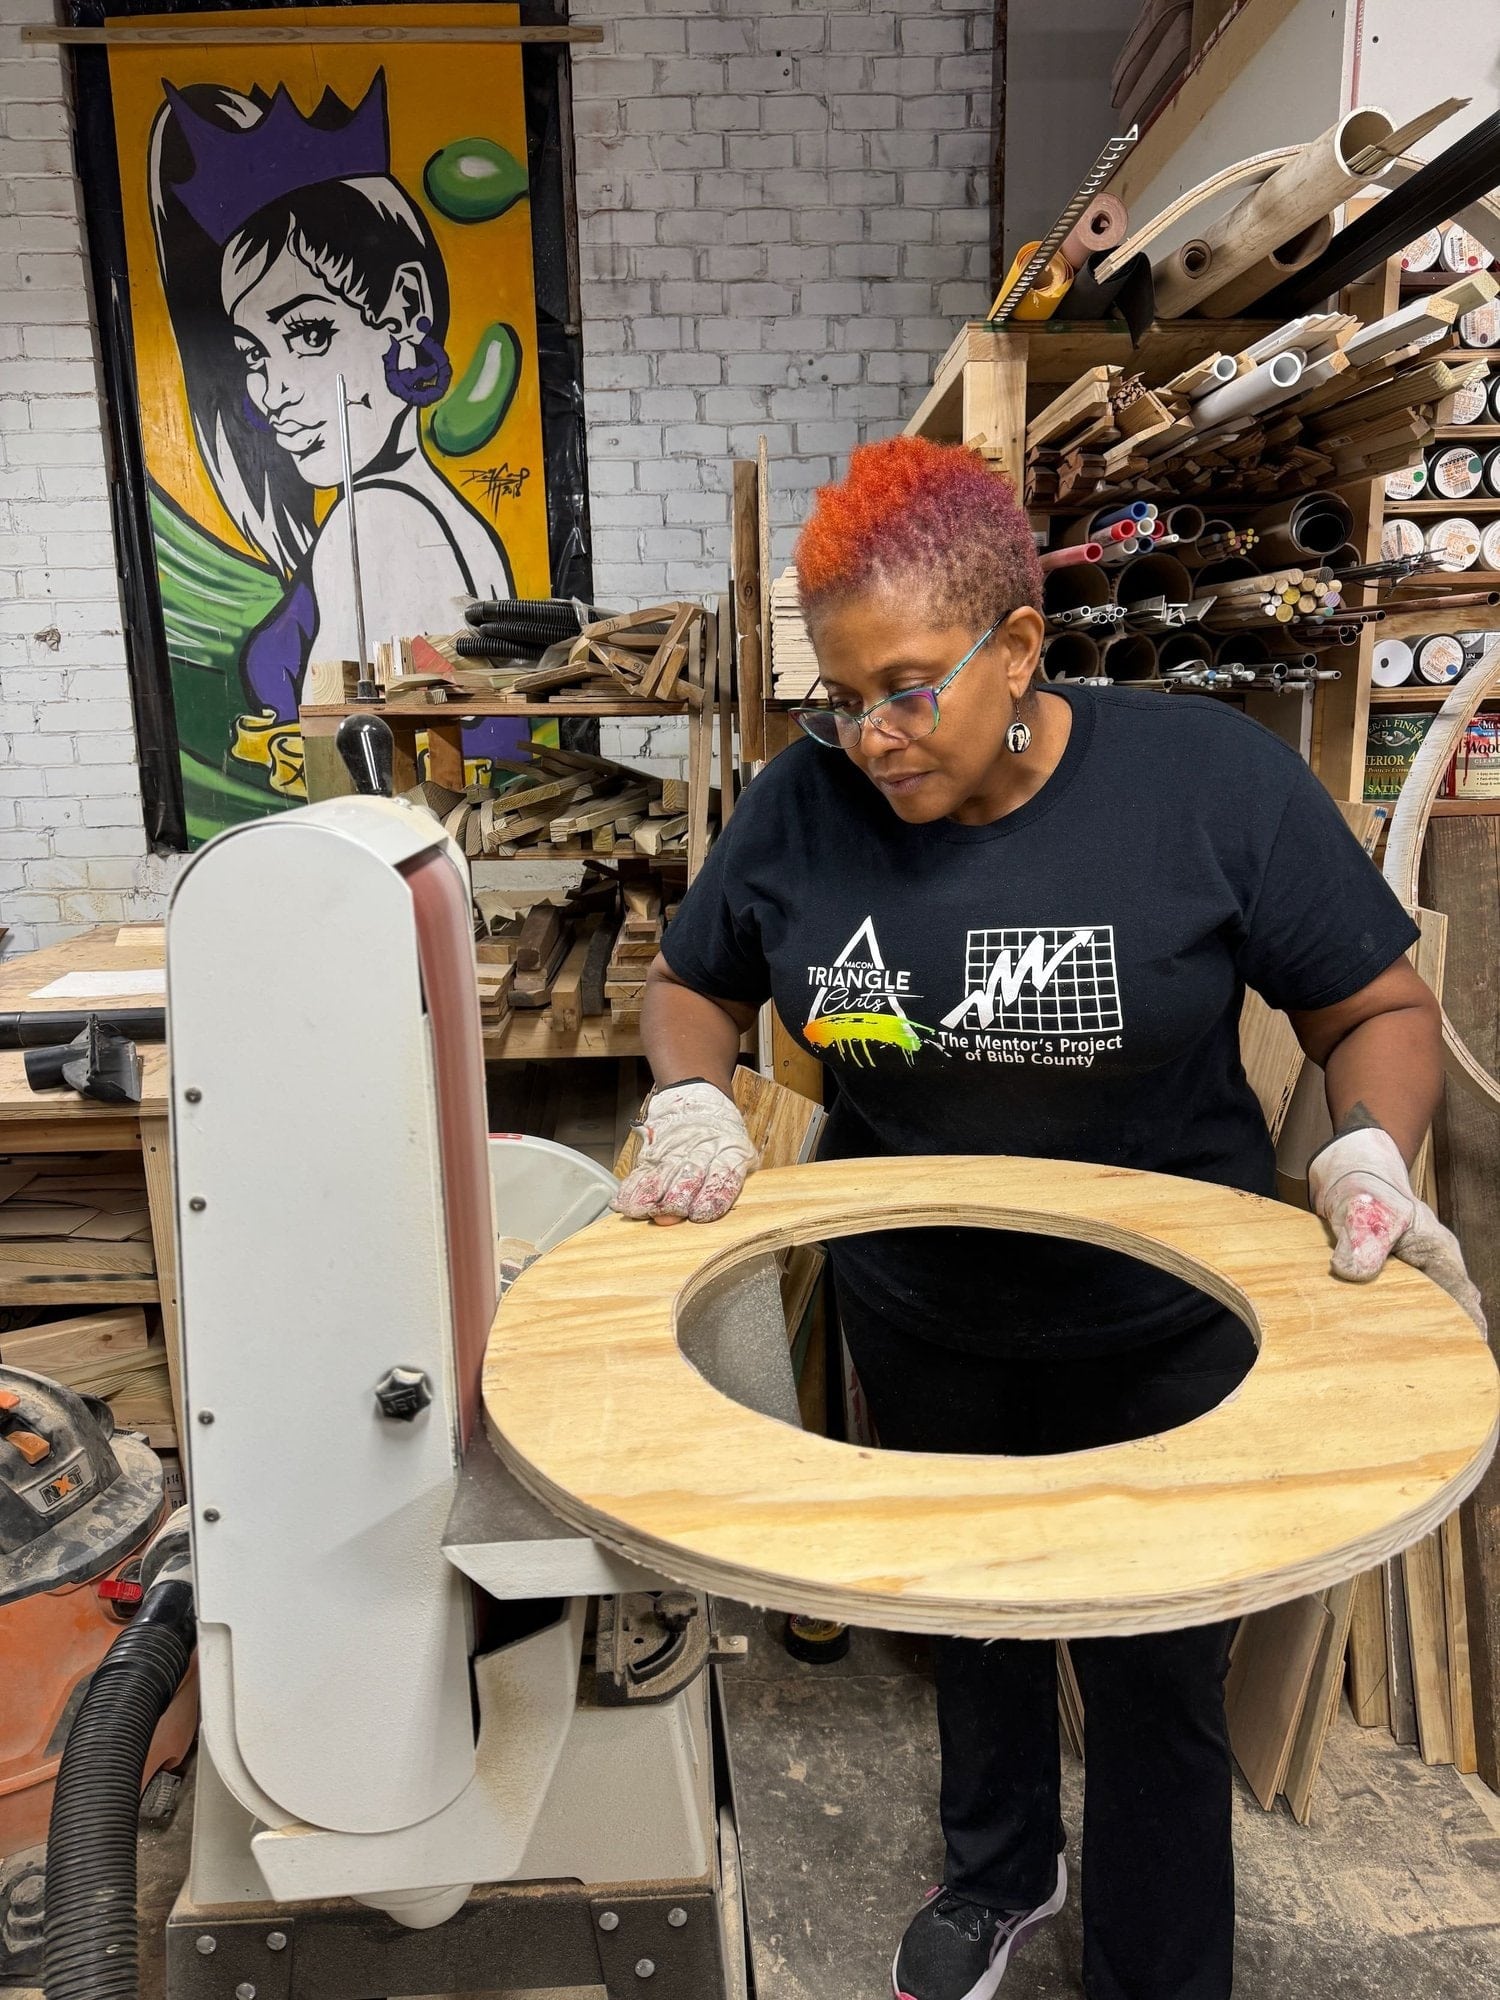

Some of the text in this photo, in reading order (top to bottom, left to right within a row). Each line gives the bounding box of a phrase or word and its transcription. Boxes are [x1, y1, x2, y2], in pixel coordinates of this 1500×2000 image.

[843, 961, 874, 970] MACON
[807, 966, 911, 991] TRIANGLE
[822, 988, 900, 1014] Arts
[938, 1031, 1123, 1055] The Mentor's Project
[965, 1050, 1095, 1068] of Bibb County
[39, 1464, 83, 1507] NXT
